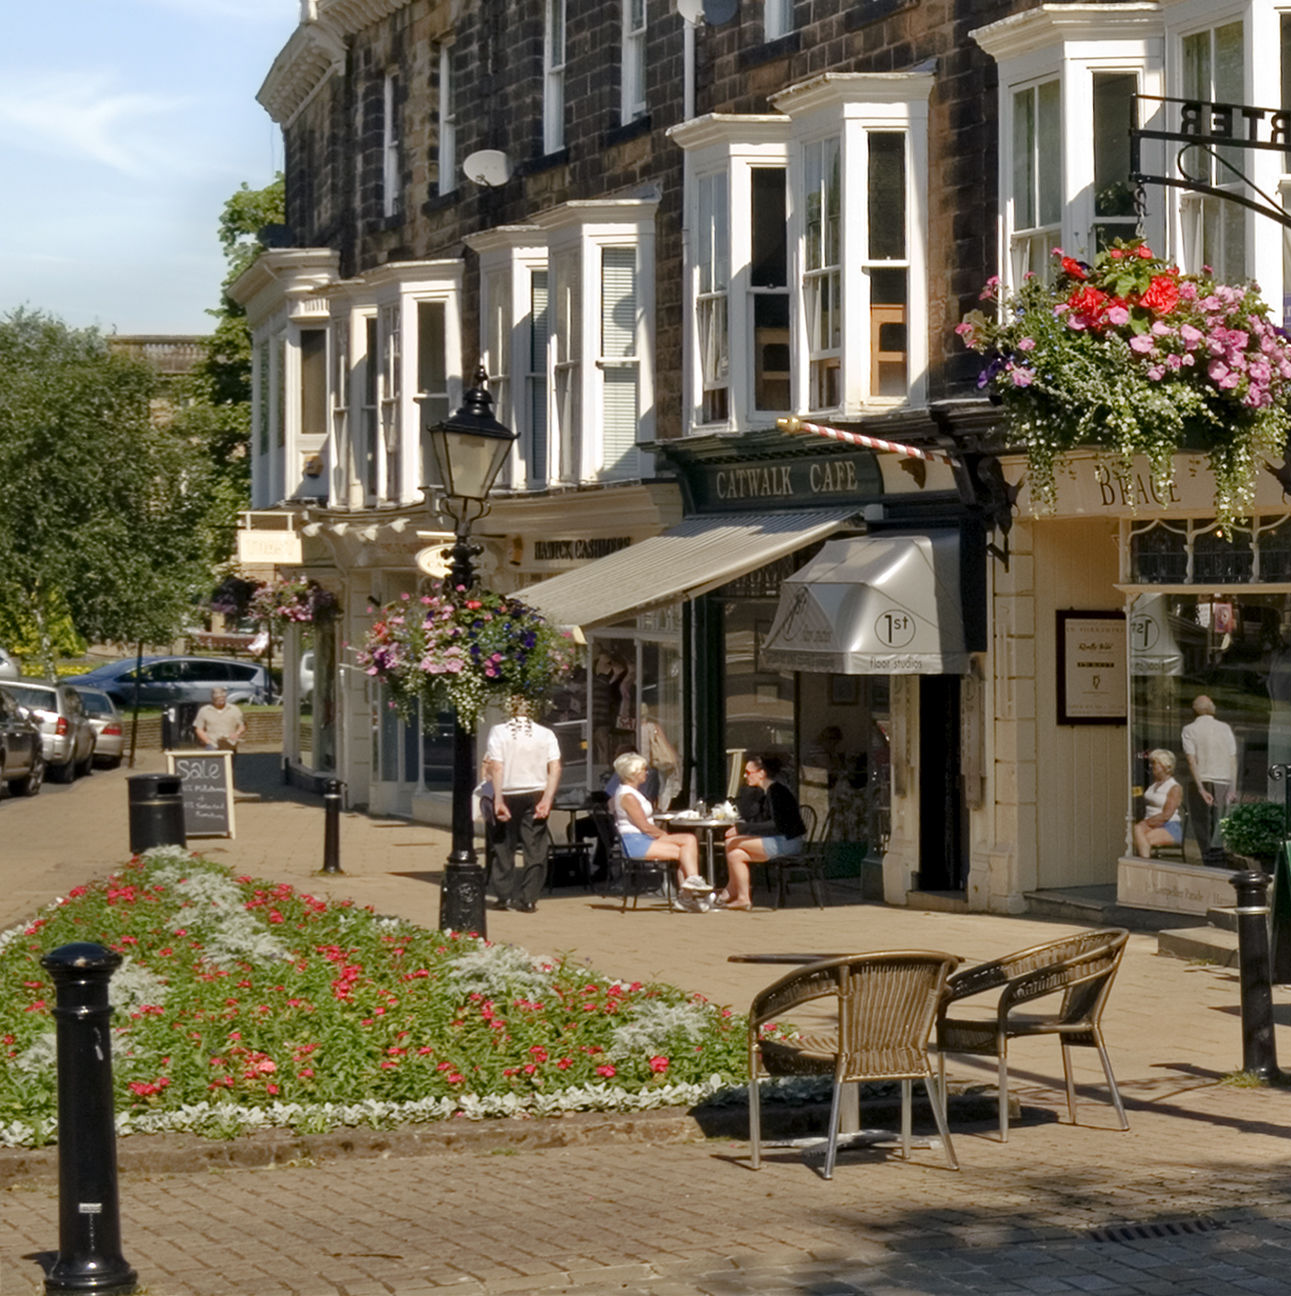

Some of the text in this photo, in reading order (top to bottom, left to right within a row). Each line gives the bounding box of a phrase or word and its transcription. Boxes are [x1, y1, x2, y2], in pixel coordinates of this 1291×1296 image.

[716, 461, 858, 499] CATWALK CAFE
[885, 614, 908, 643] 1st
[893, 659, 923, 670] studios
[177, 759, 220, 781] Sale
